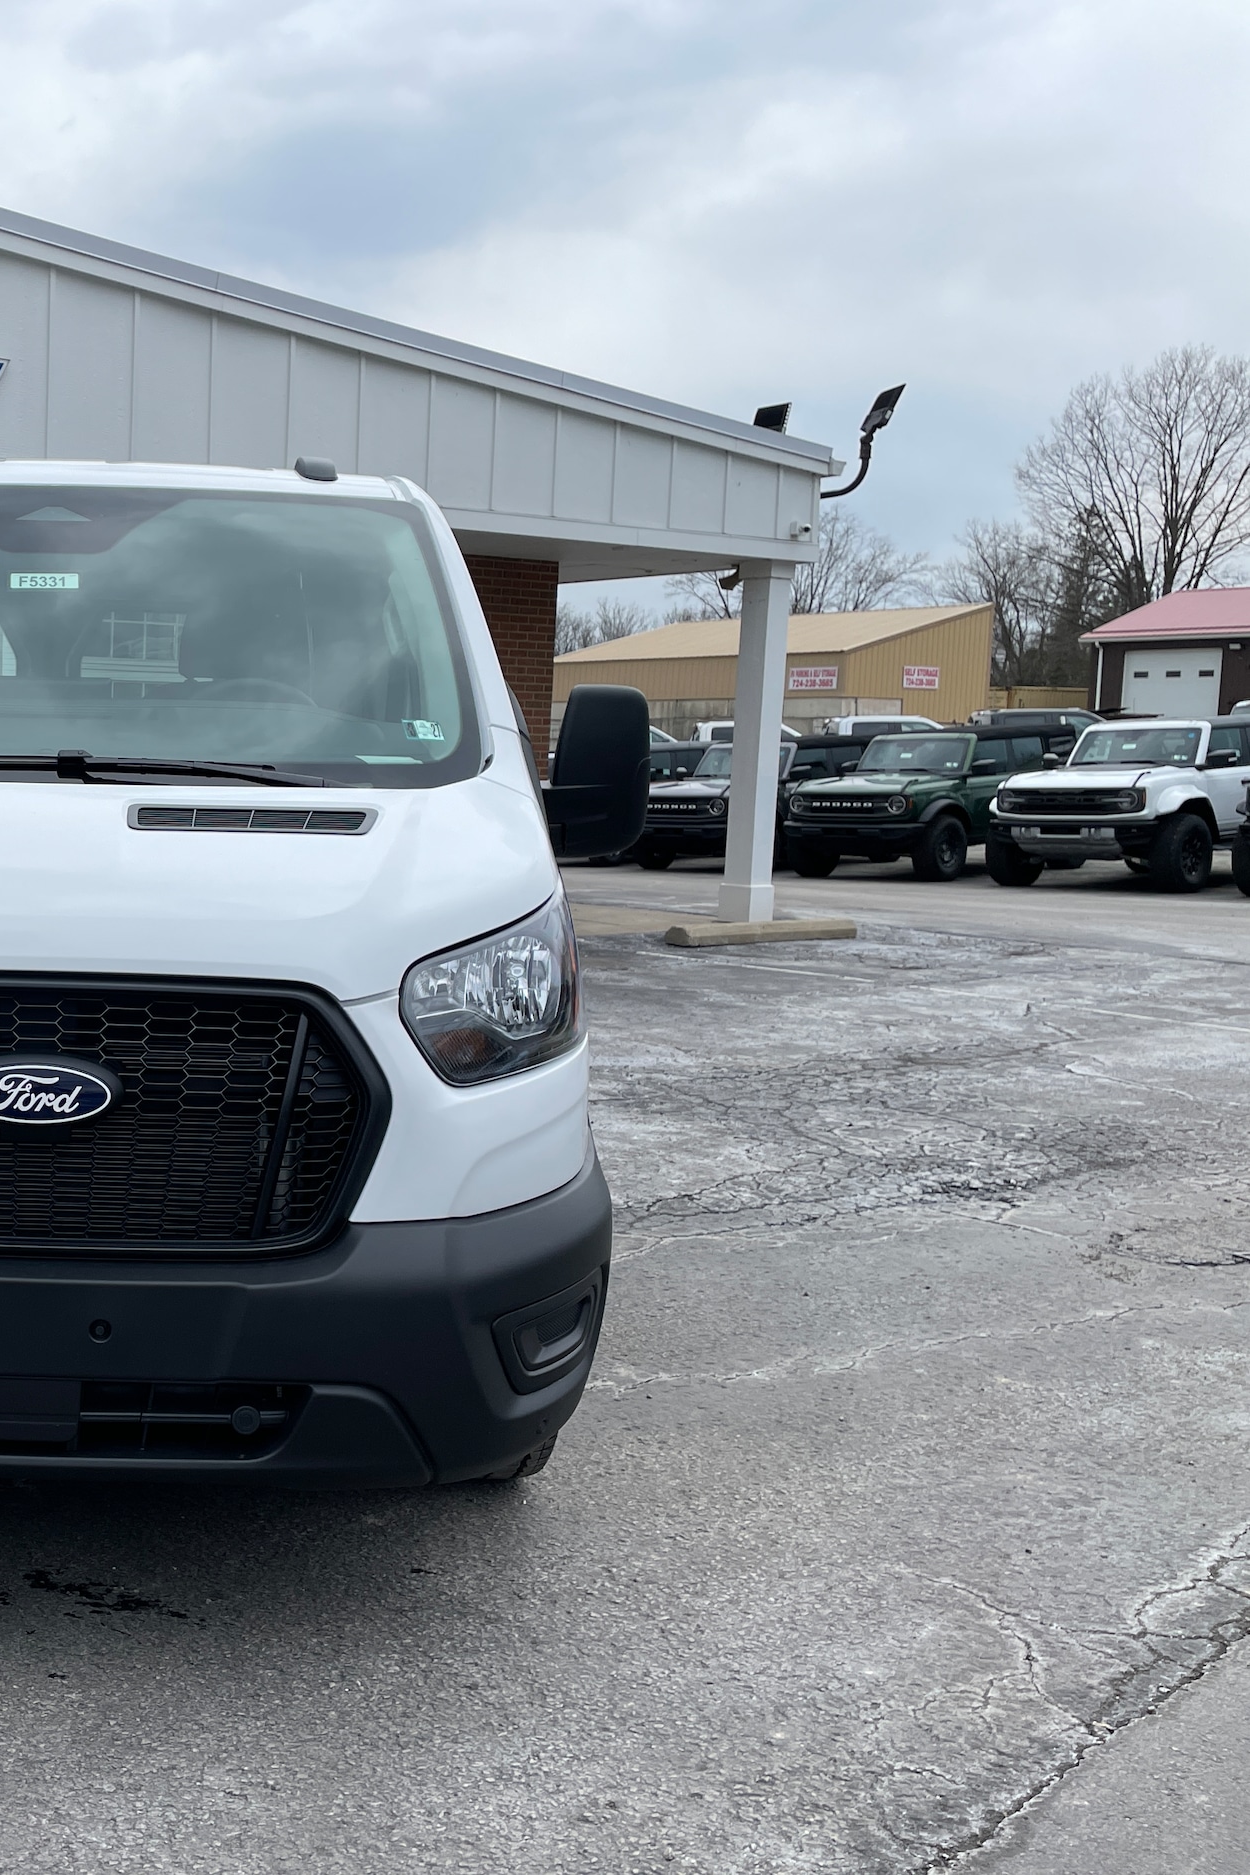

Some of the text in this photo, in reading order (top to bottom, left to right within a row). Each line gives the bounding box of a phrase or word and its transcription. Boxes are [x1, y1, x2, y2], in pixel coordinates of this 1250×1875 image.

[19, 576, 66, 587] F5331
[905, 668, 938, 678] SELF STORAGE
